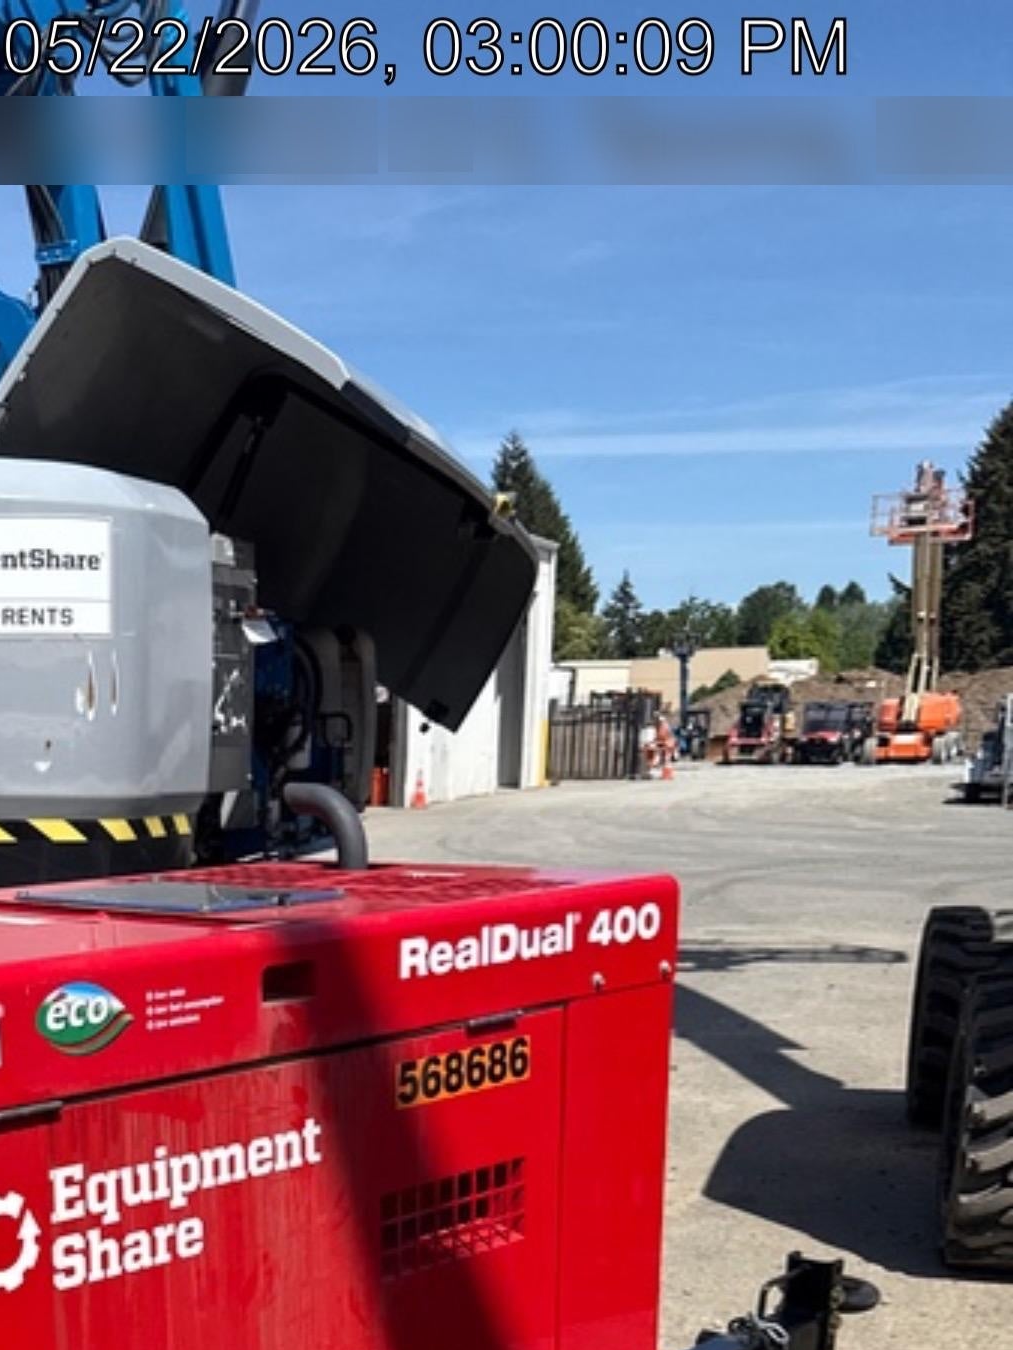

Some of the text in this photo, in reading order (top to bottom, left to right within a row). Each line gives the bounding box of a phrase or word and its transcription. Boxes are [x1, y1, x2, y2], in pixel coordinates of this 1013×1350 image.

[399, 902, 661, 979] RealDual 400
[398, 1037, 529, 1104] 568686
[49, 1118, 322, 1225] Equipment
[51, 1216, 204, 1291] Share
